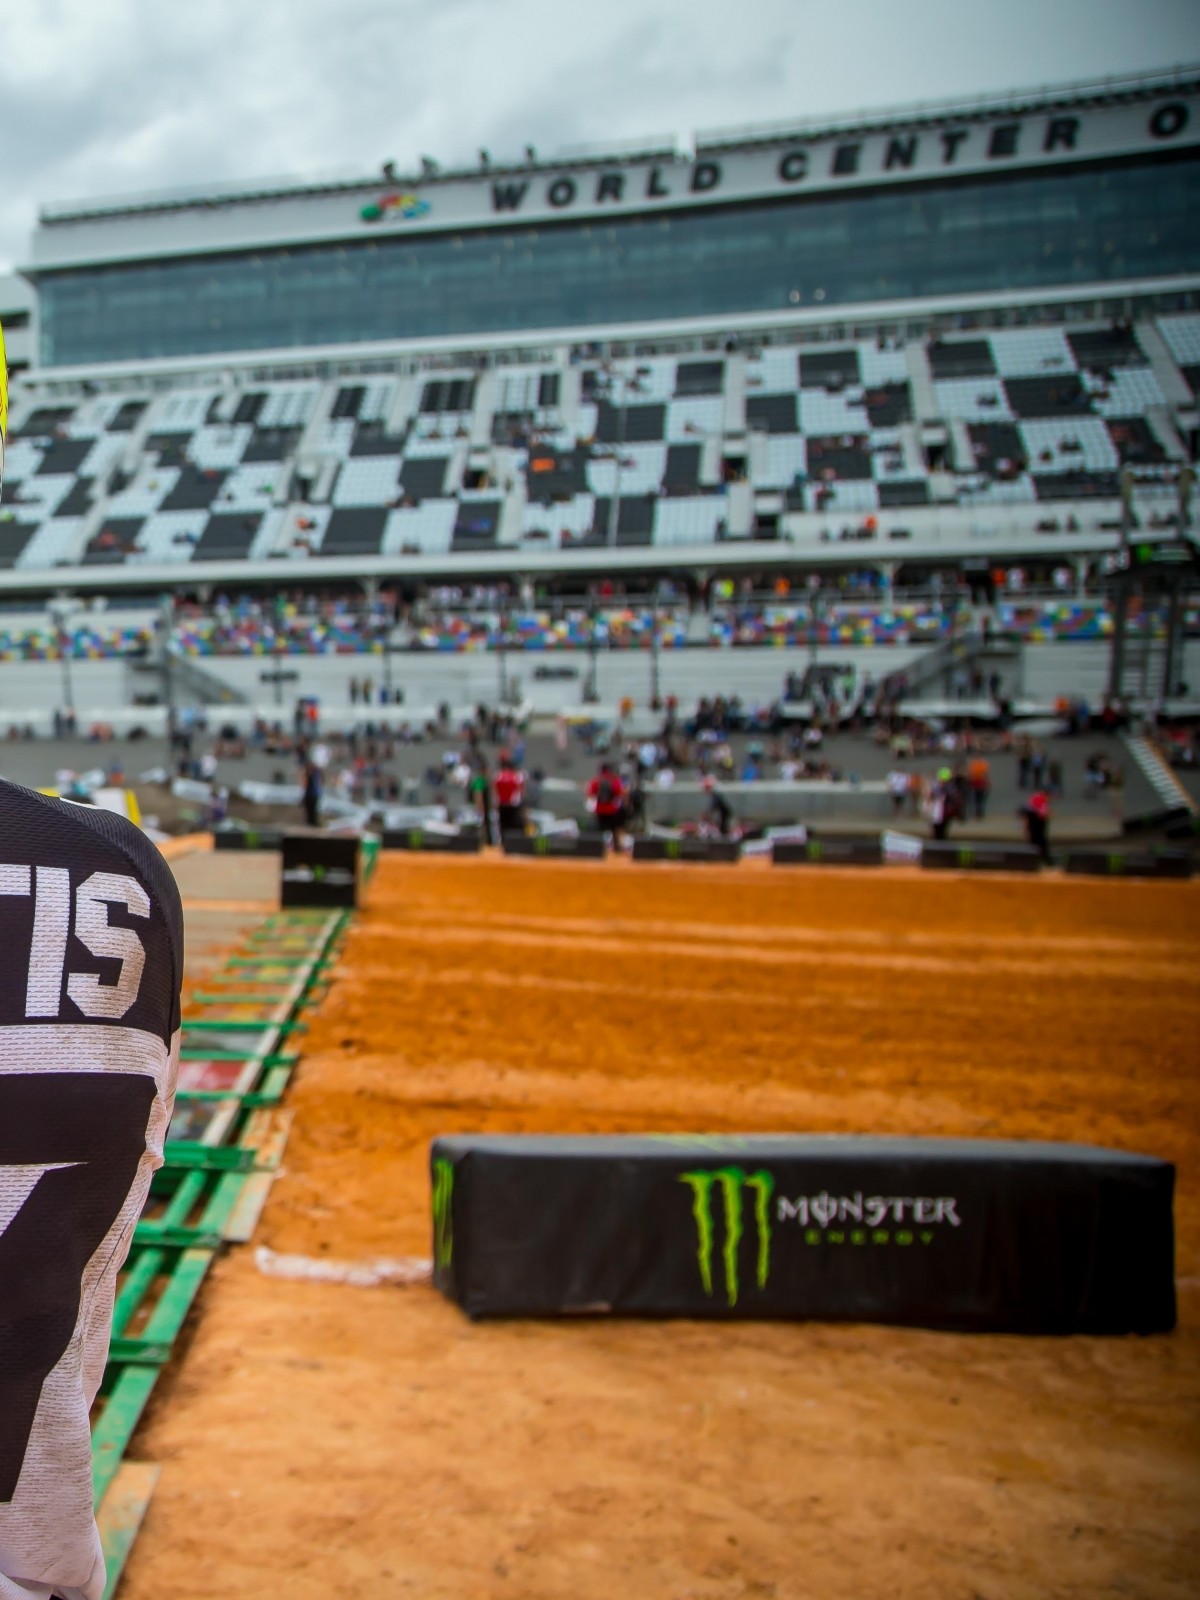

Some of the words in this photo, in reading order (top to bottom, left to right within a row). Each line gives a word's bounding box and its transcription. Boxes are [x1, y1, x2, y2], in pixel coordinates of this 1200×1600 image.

[492, 161, 721, 212] WORLD
[777, 116, 1079, 182] CENTER
[777, 1190, 961, 1228] MONSTER
